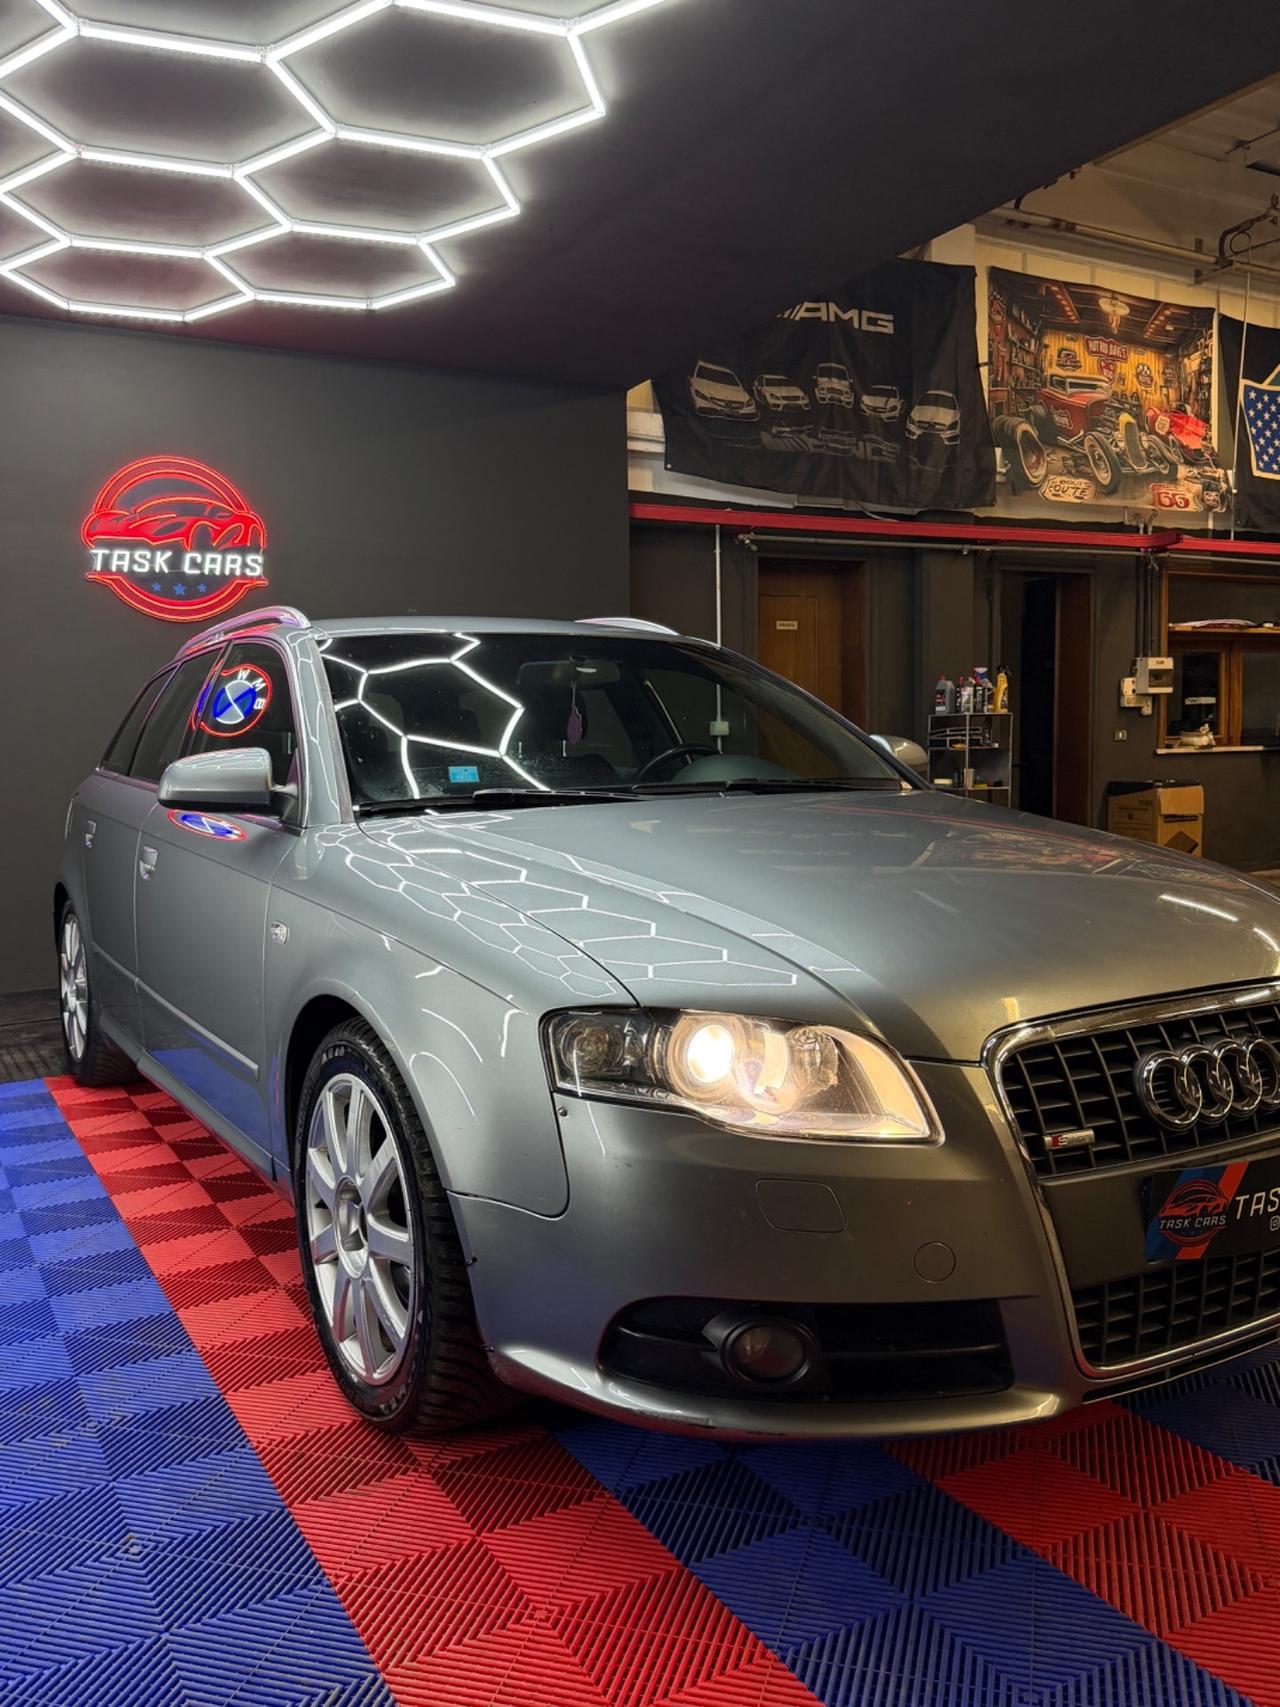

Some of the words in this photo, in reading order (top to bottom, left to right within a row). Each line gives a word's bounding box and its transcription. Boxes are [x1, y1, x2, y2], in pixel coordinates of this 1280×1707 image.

[795, 301, 894, 335] AMG
[1157, 491, 1190, 509] 66
[91, 549, 172, 574] TASK
[183, 552, 264, 577] CARS
[1160, 1217, 1192, 1229] TASK
[1194, 1215, 1227, 1228] CARS
